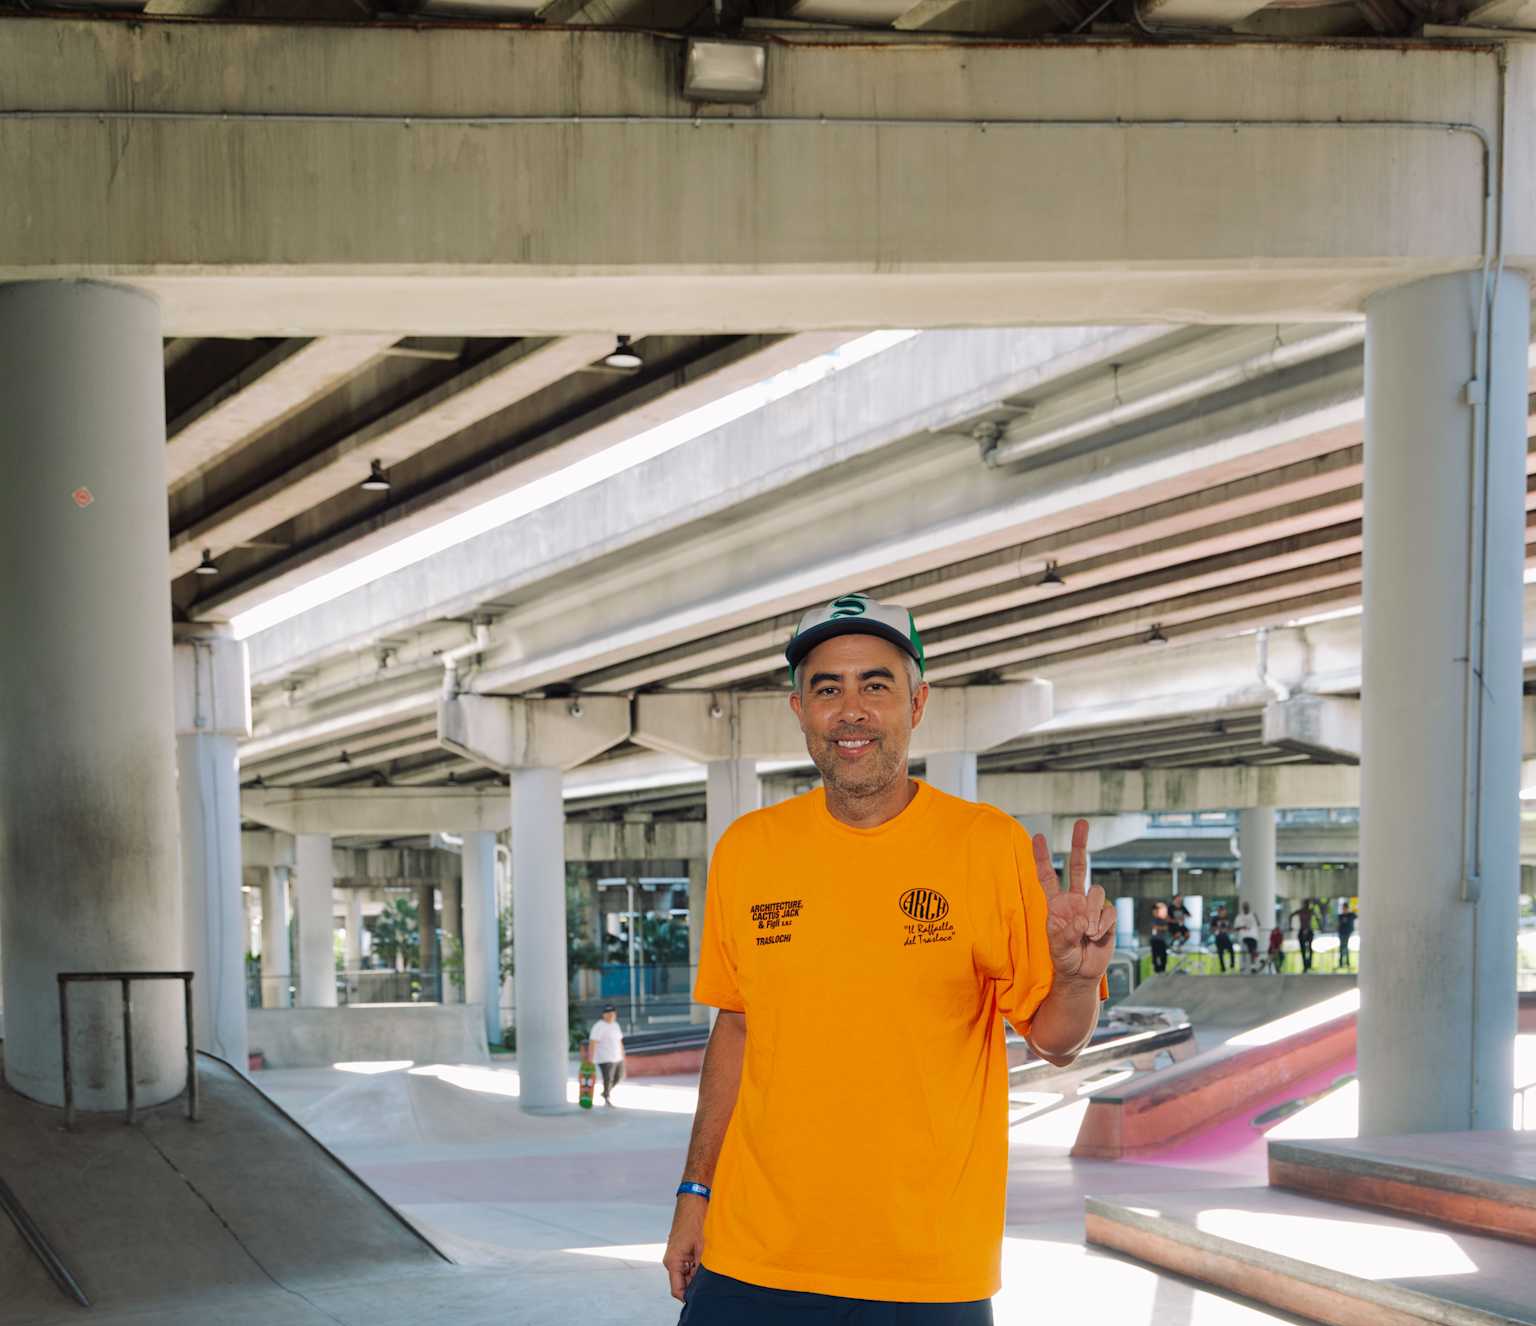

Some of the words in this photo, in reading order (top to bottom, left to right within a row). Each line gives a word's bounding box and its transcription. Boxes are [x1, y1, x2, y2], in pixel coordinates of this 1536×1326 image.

[903, 890, 946, 919] ARCH
[752, 911, 780, 921] CACTUS
[781, 909, 799, 918] JACK
[756, 934, 792, 945] TRASLOCHI
